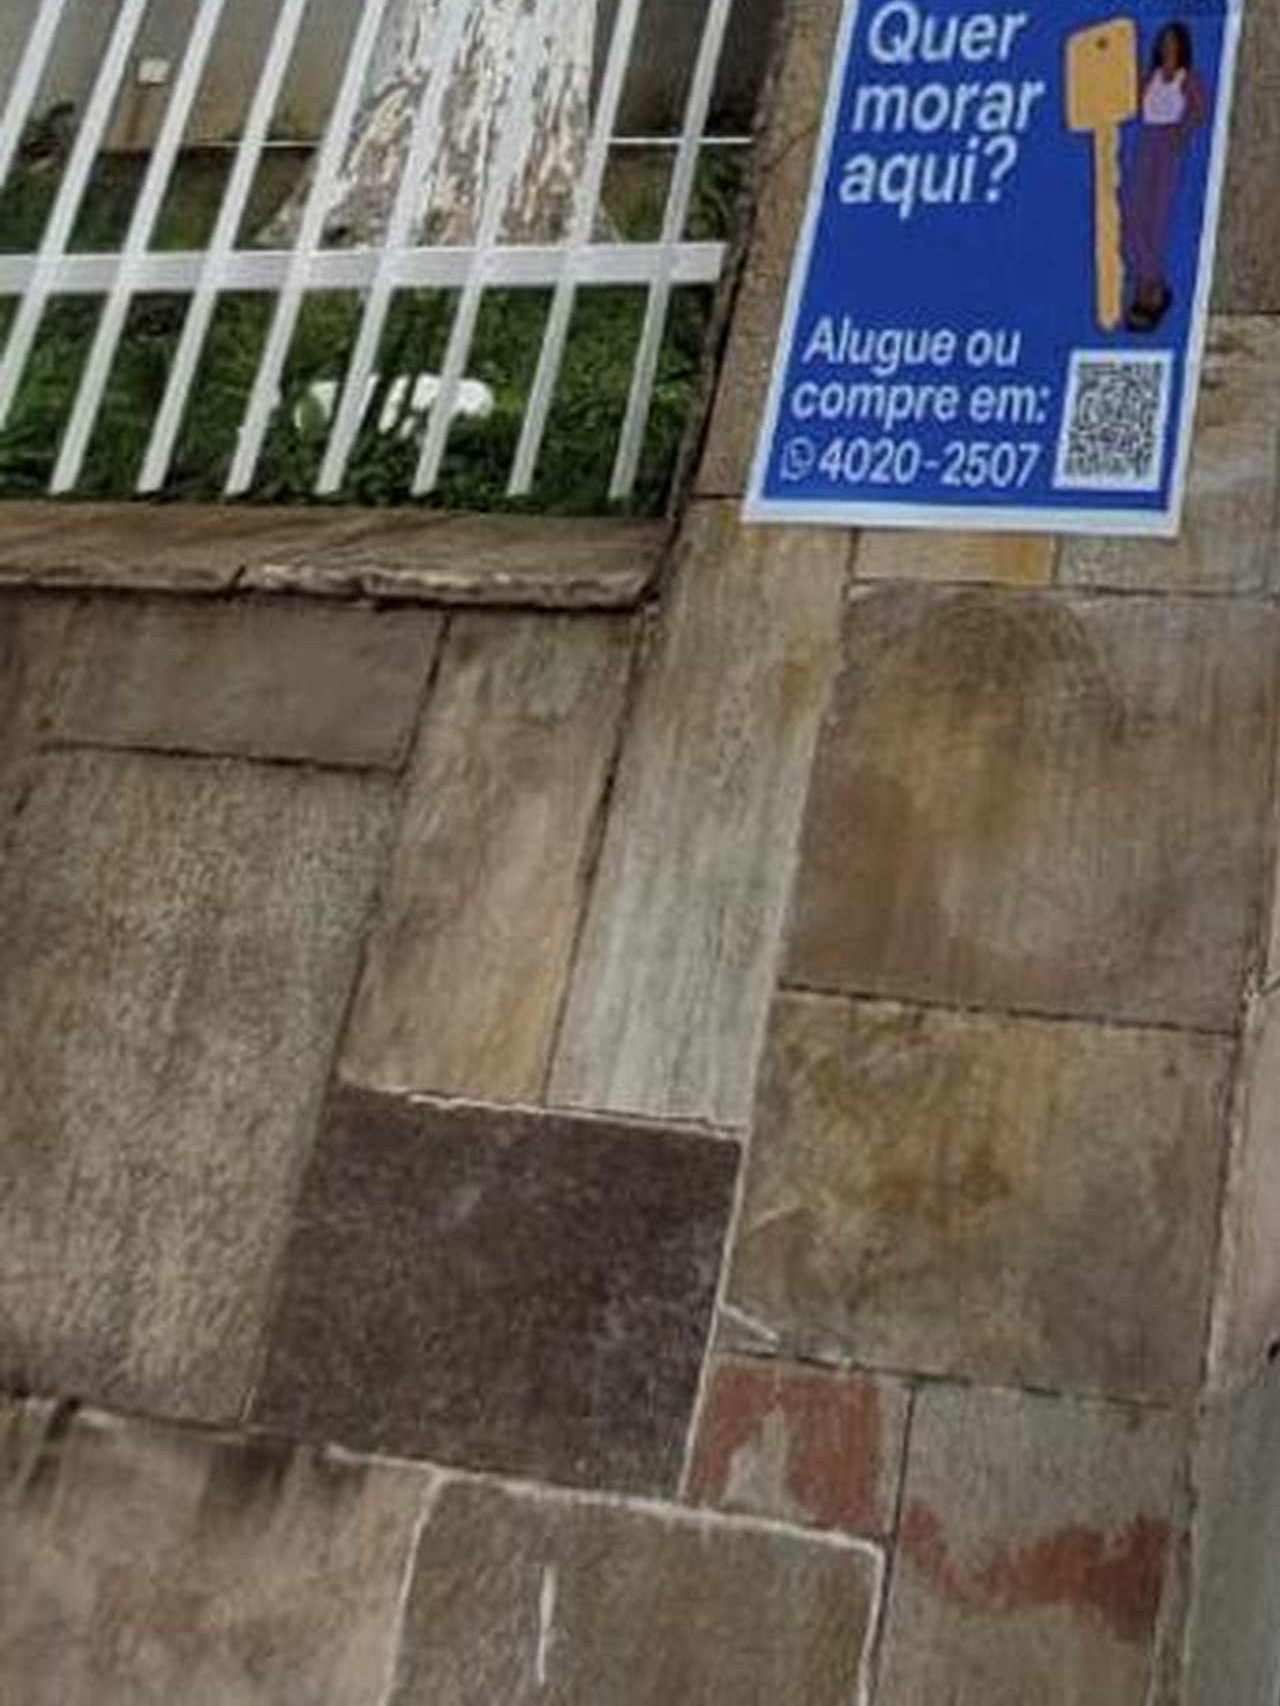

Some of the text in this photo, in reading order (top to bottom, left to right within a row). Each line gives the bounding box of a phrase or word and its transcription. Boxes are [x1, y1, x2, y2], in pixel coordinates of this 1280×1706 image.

[852, 80, 1046, 133] morar
[838, 134, 1018, 221] aqui?
[801, 315, 1022, 377] Alugue ou
[791, 381, 1051, 432] compre em:
[818, 438, 1042, 489] 4020-2507
